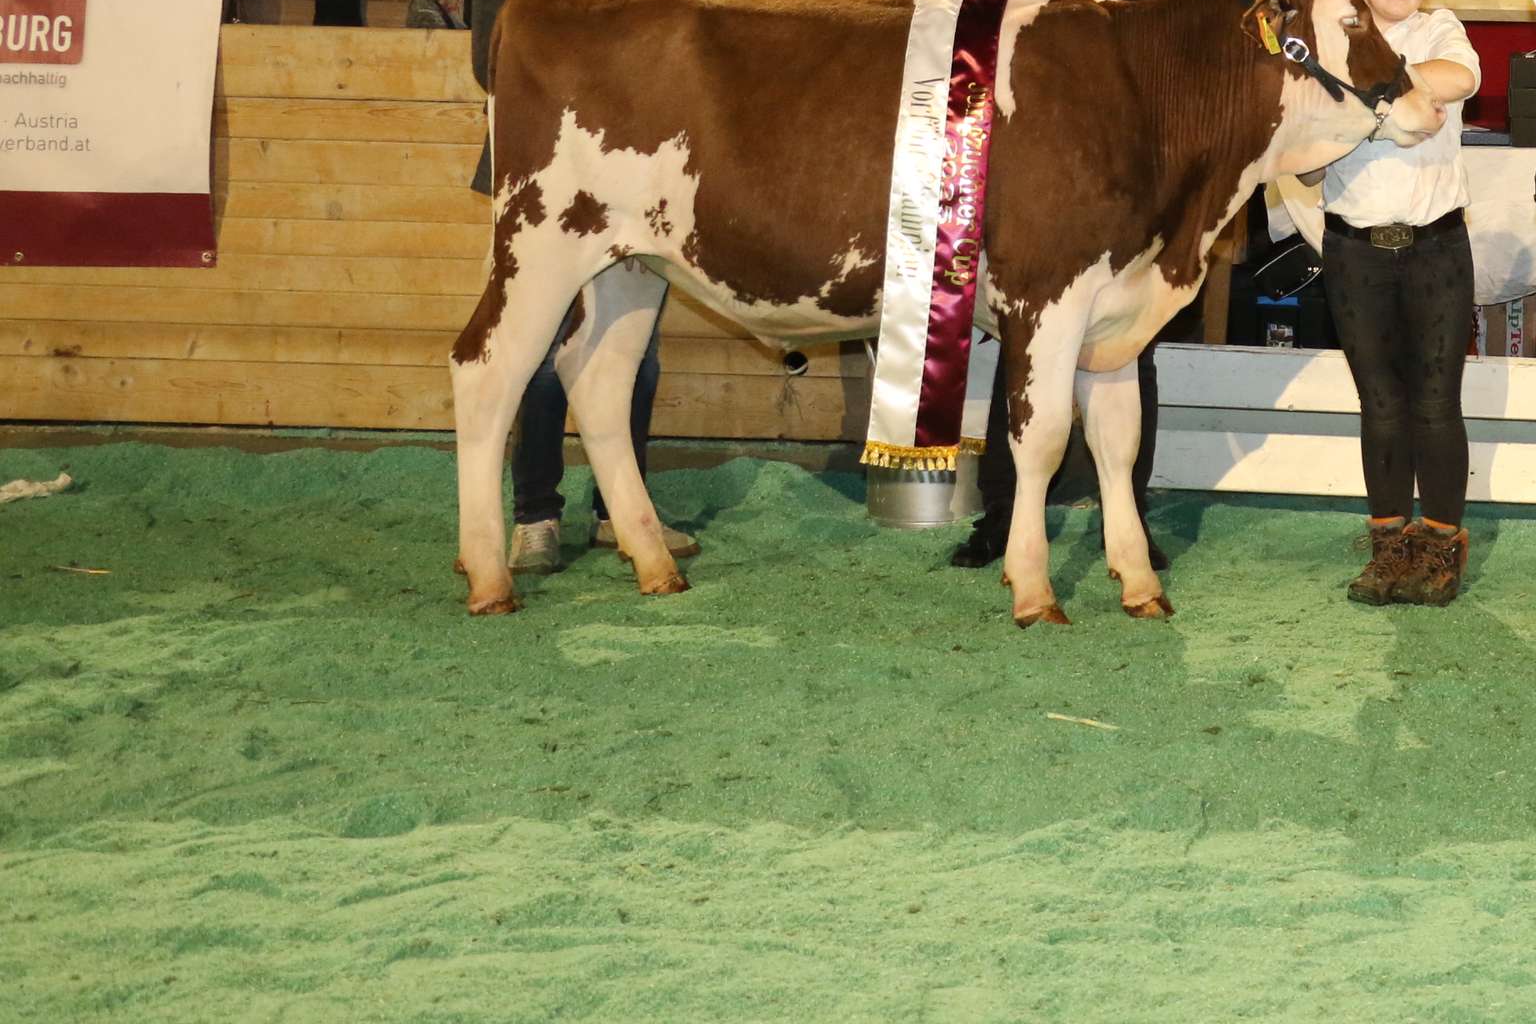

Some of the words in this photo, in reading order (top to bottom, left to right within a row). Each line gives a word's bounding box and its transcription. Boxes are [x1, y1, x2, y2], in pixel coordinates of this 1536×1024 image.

[0, 14, 73, 53] URG
[14, 112, 79, 129] Austria
[944, 238, 979, 287] Cup
